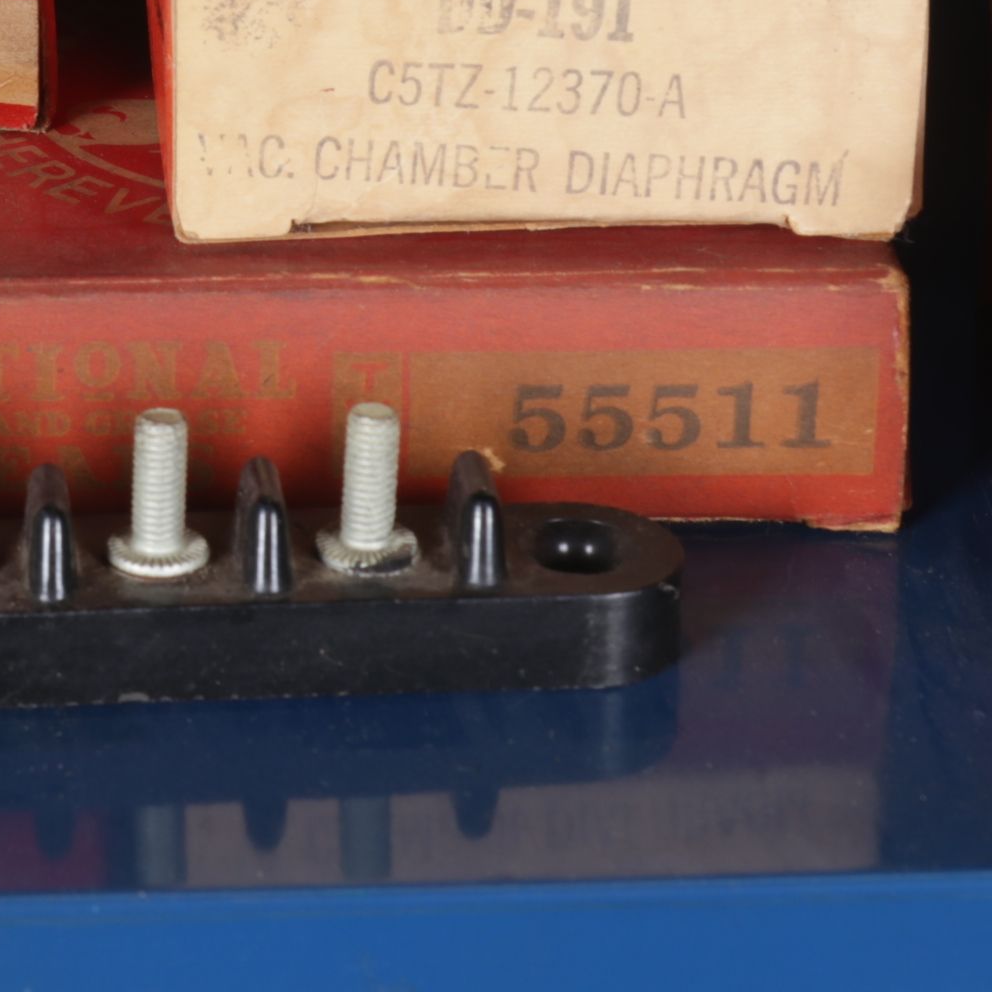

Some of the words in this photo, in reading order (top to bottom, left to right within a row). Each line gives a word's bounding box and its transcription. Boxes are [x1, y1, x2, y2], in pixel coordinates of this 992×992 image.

[366, 59, 687, 119] C5TZ-12370-A
[565, 149, 850, 208] DIAPHRAGM
[509, 380, 831, 454] 55511
